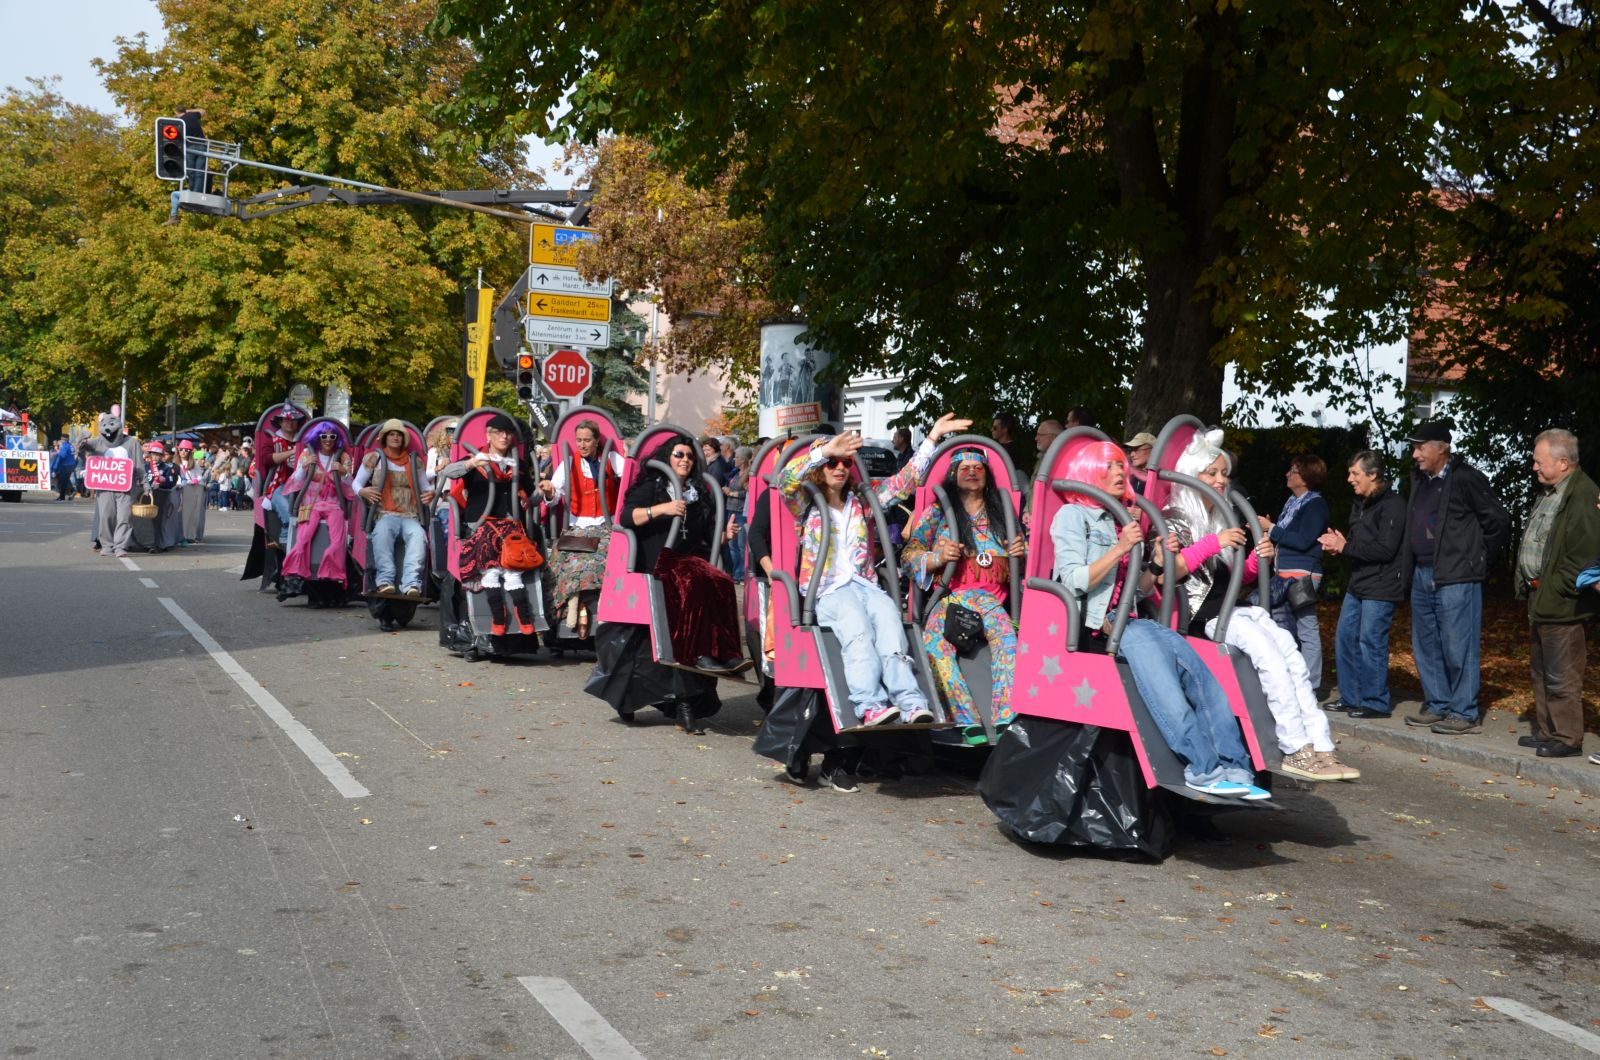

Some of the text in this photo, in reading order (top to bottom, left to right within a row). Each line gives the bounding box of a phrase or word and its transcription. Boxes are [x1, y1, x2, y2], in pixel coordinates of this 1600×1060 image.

[551, 298, 580, 306] Gaildorf
[550, 306, 587, 316] Frankenhardt
[547, 324, 573, 333] Zentrum
[531, 331, 572, 340] Altenmünster
[547, 363, 587, 384] STOP
[11, 450, 36, 459] FIGHT
[39, 452, 49, 490] LIVE
[89, 461, 127, 472] WILDE
[91, 472, 127, 485] MAUS
